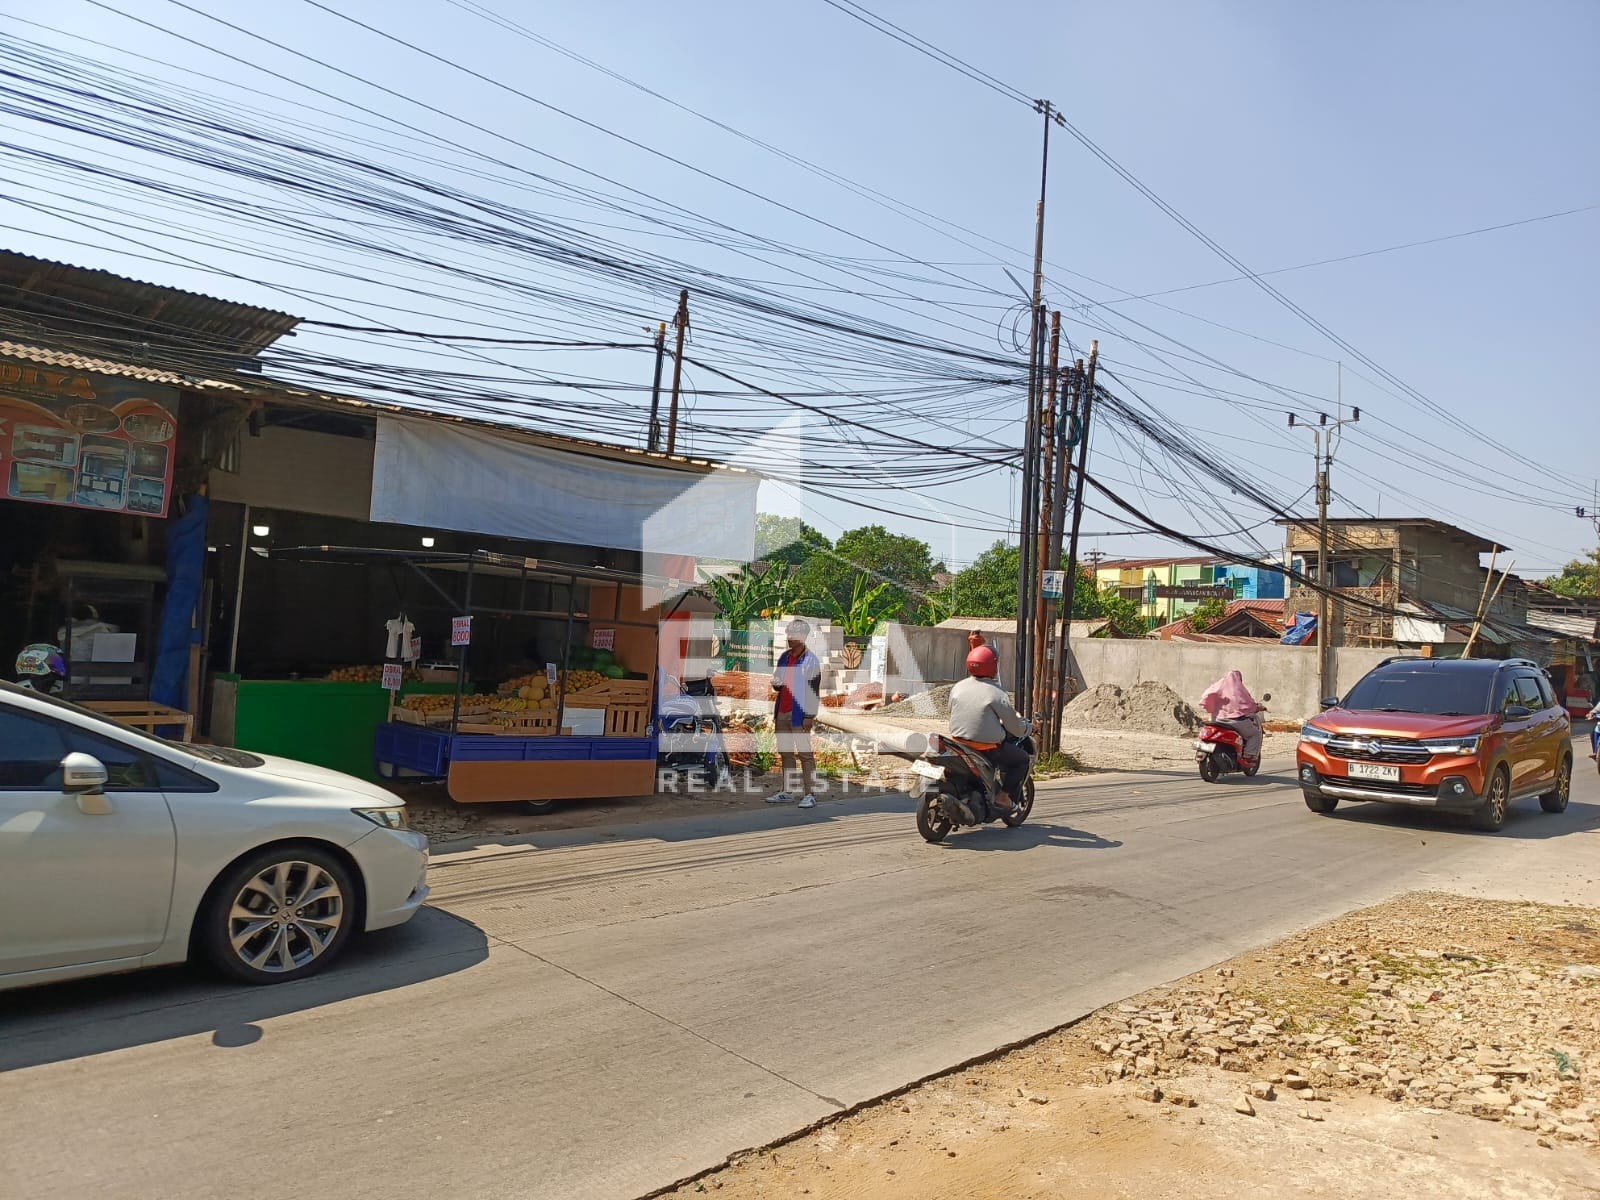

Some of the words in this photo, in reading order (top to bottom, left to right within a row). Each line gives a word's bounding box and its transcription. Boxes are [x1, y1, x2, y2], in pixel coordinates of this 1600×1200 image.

[1350, 764, 1354, 772] B
[1360, 764, 1379, 774] 1722
[1382, 767, 1398, 776] ZKY
